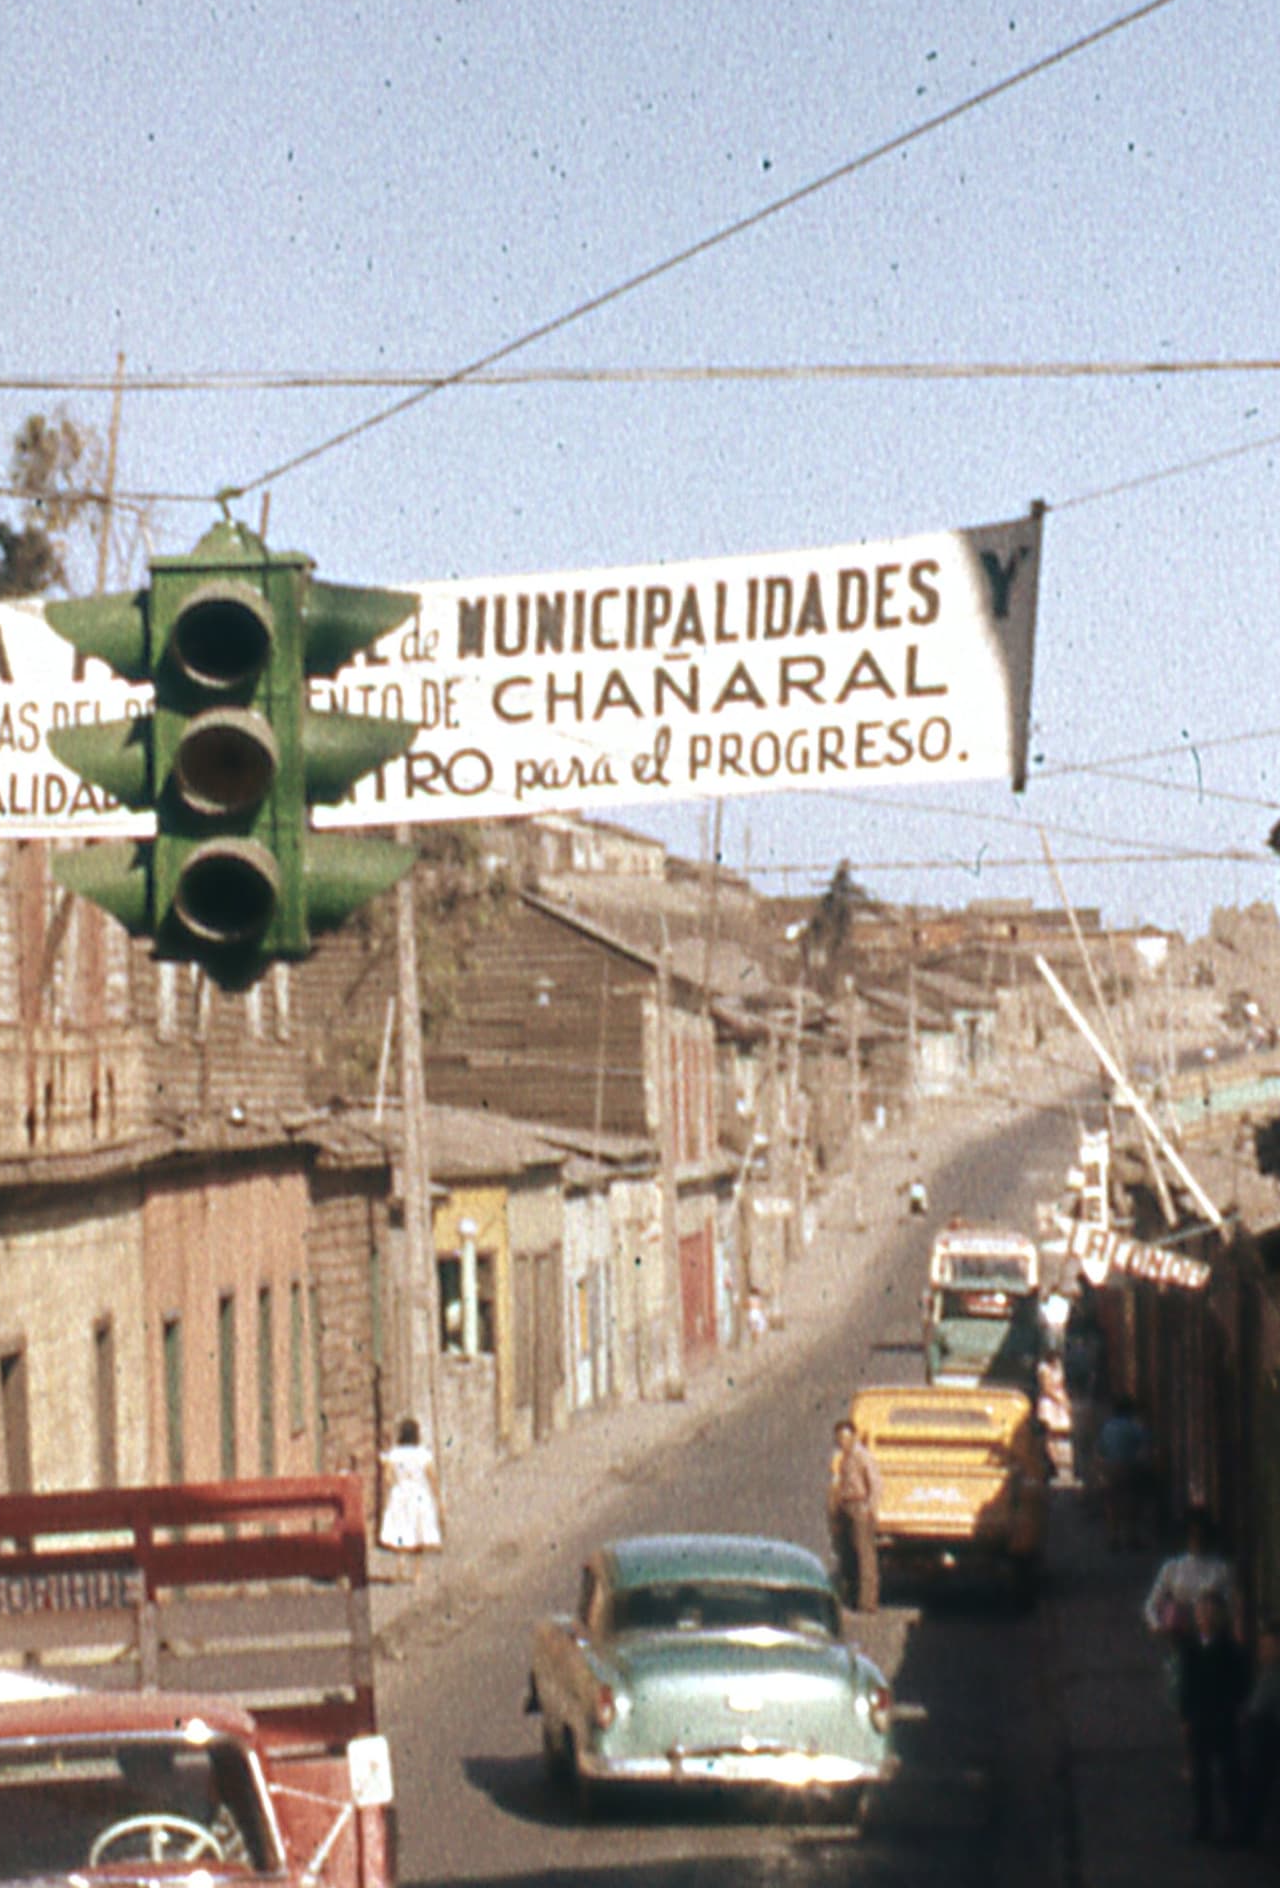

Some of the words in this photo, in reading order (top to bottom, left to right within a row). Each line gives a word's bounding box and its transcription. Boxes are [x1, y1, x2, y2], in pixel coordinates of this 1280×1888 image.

[456, 558, 940, 661] MUNICIPALIDADES
[421, 677, 462, 731] DE
[491, 643, 949, 726] CHAÑARAL
[514, 754, 619, 800] para
[631, 724, 673, 788] el
[688, 715, 969, 782] PROGRESO.
